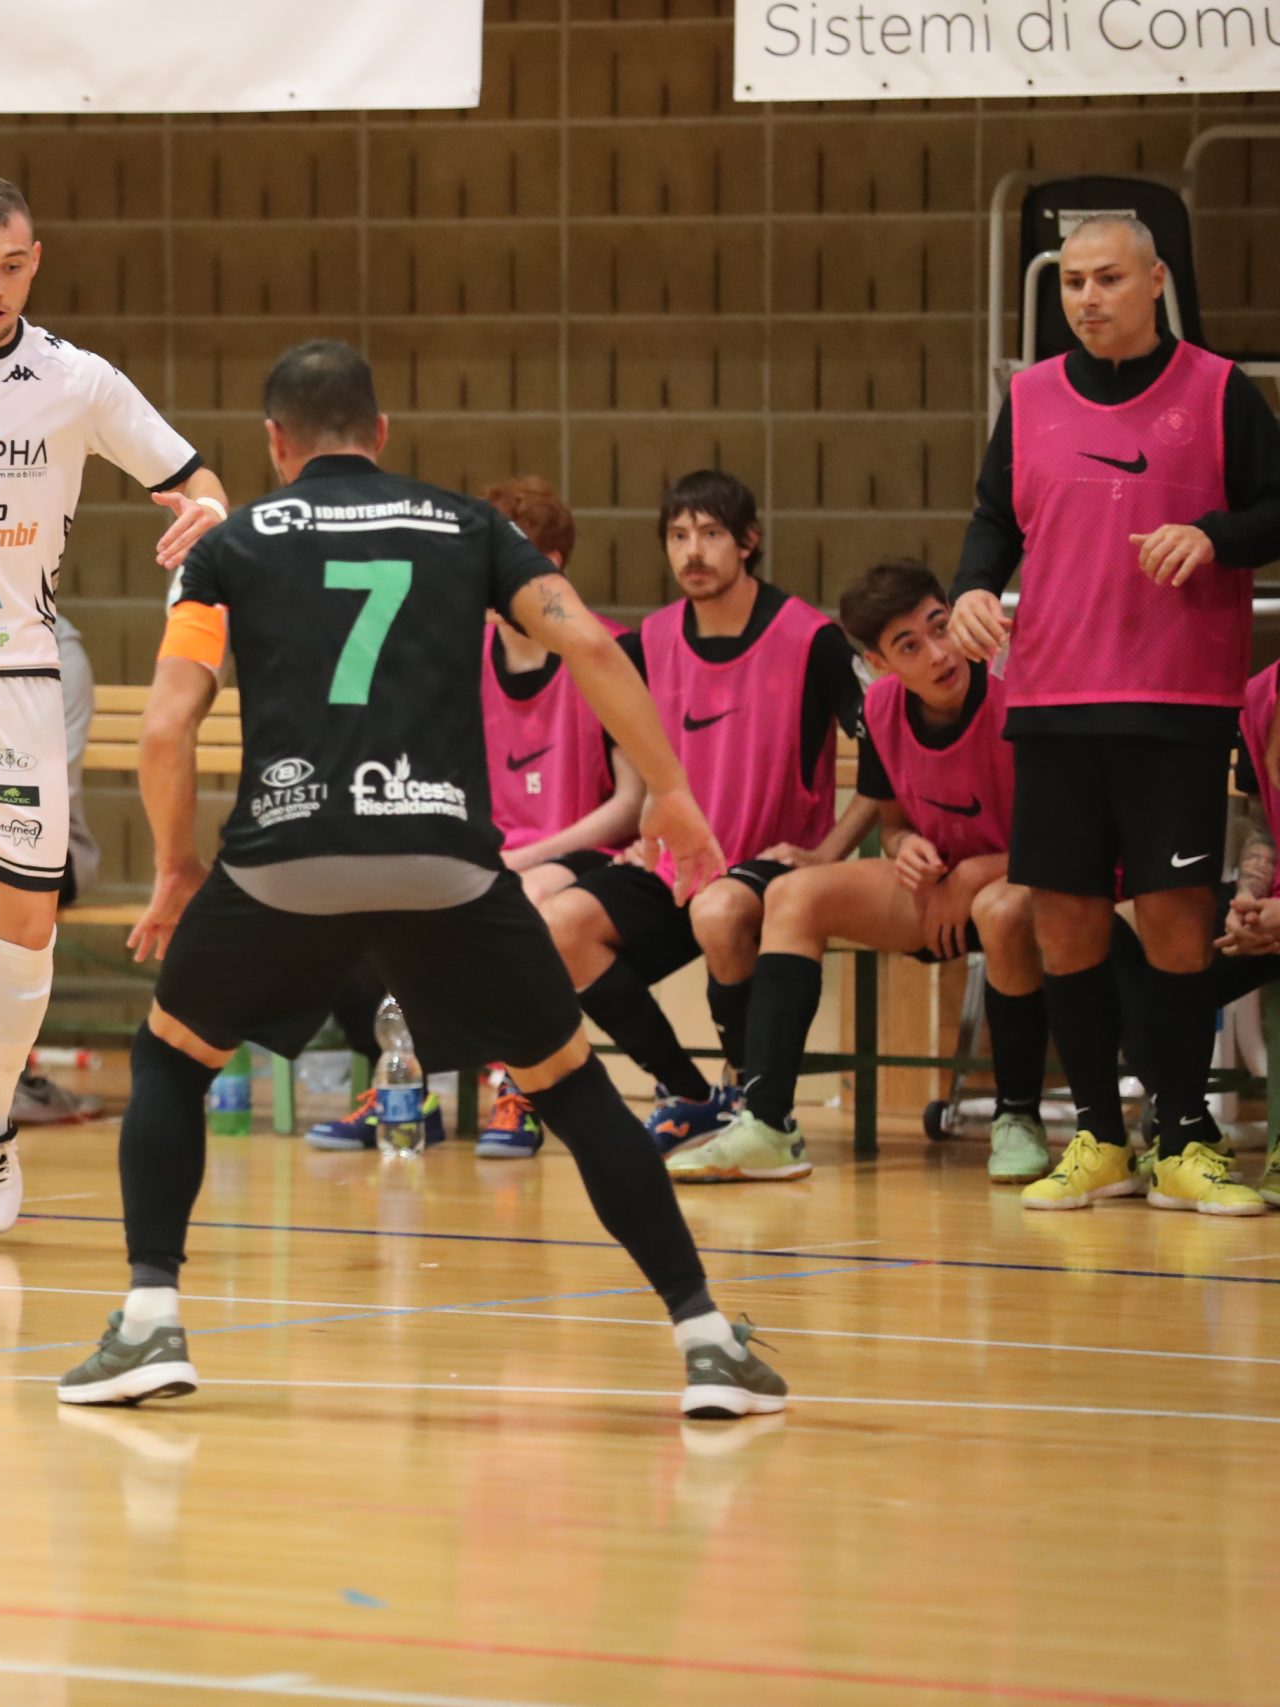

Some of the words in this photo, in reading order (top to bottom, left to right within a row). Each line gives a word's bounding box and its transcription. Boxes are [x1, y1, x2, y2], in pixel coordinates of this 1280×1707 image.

[763, 2, 991, 57] Sistemi
[1017, 0, 1071, 52] di
[324, 560, 413, 705] 7
[251, 783, 329, 818] BATISTI
[524, 771, 542, 796] 15
